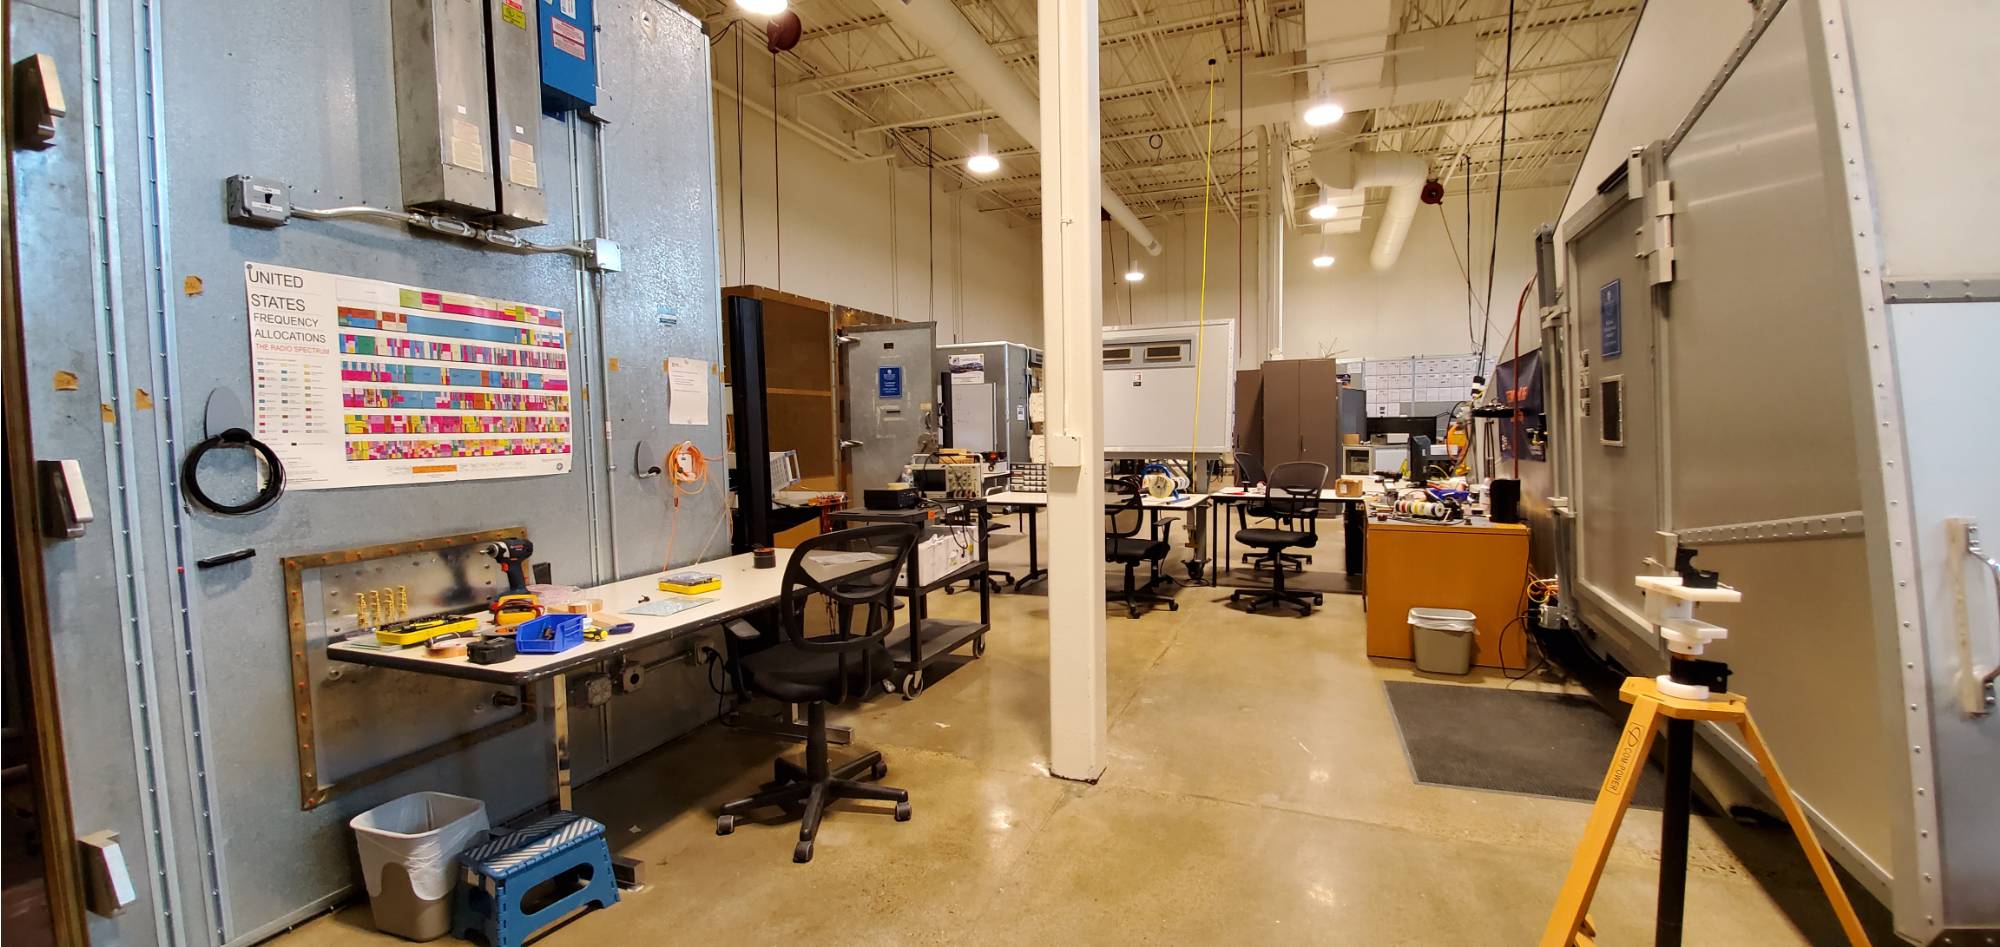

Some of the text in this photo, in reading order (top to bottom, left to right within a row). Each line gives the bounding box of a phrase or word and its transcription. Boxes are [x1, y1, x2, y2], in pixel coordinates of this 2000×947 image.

[248, 270, 303, 288] UNITED
[251, 293, 306, 312] STATES
[253, 312, 319, 328] FREQUENCY
[255, 329, 327, 344] ALLOCATIONS
[256, 343, 330, 355] THE RADIO SPECTRUM
